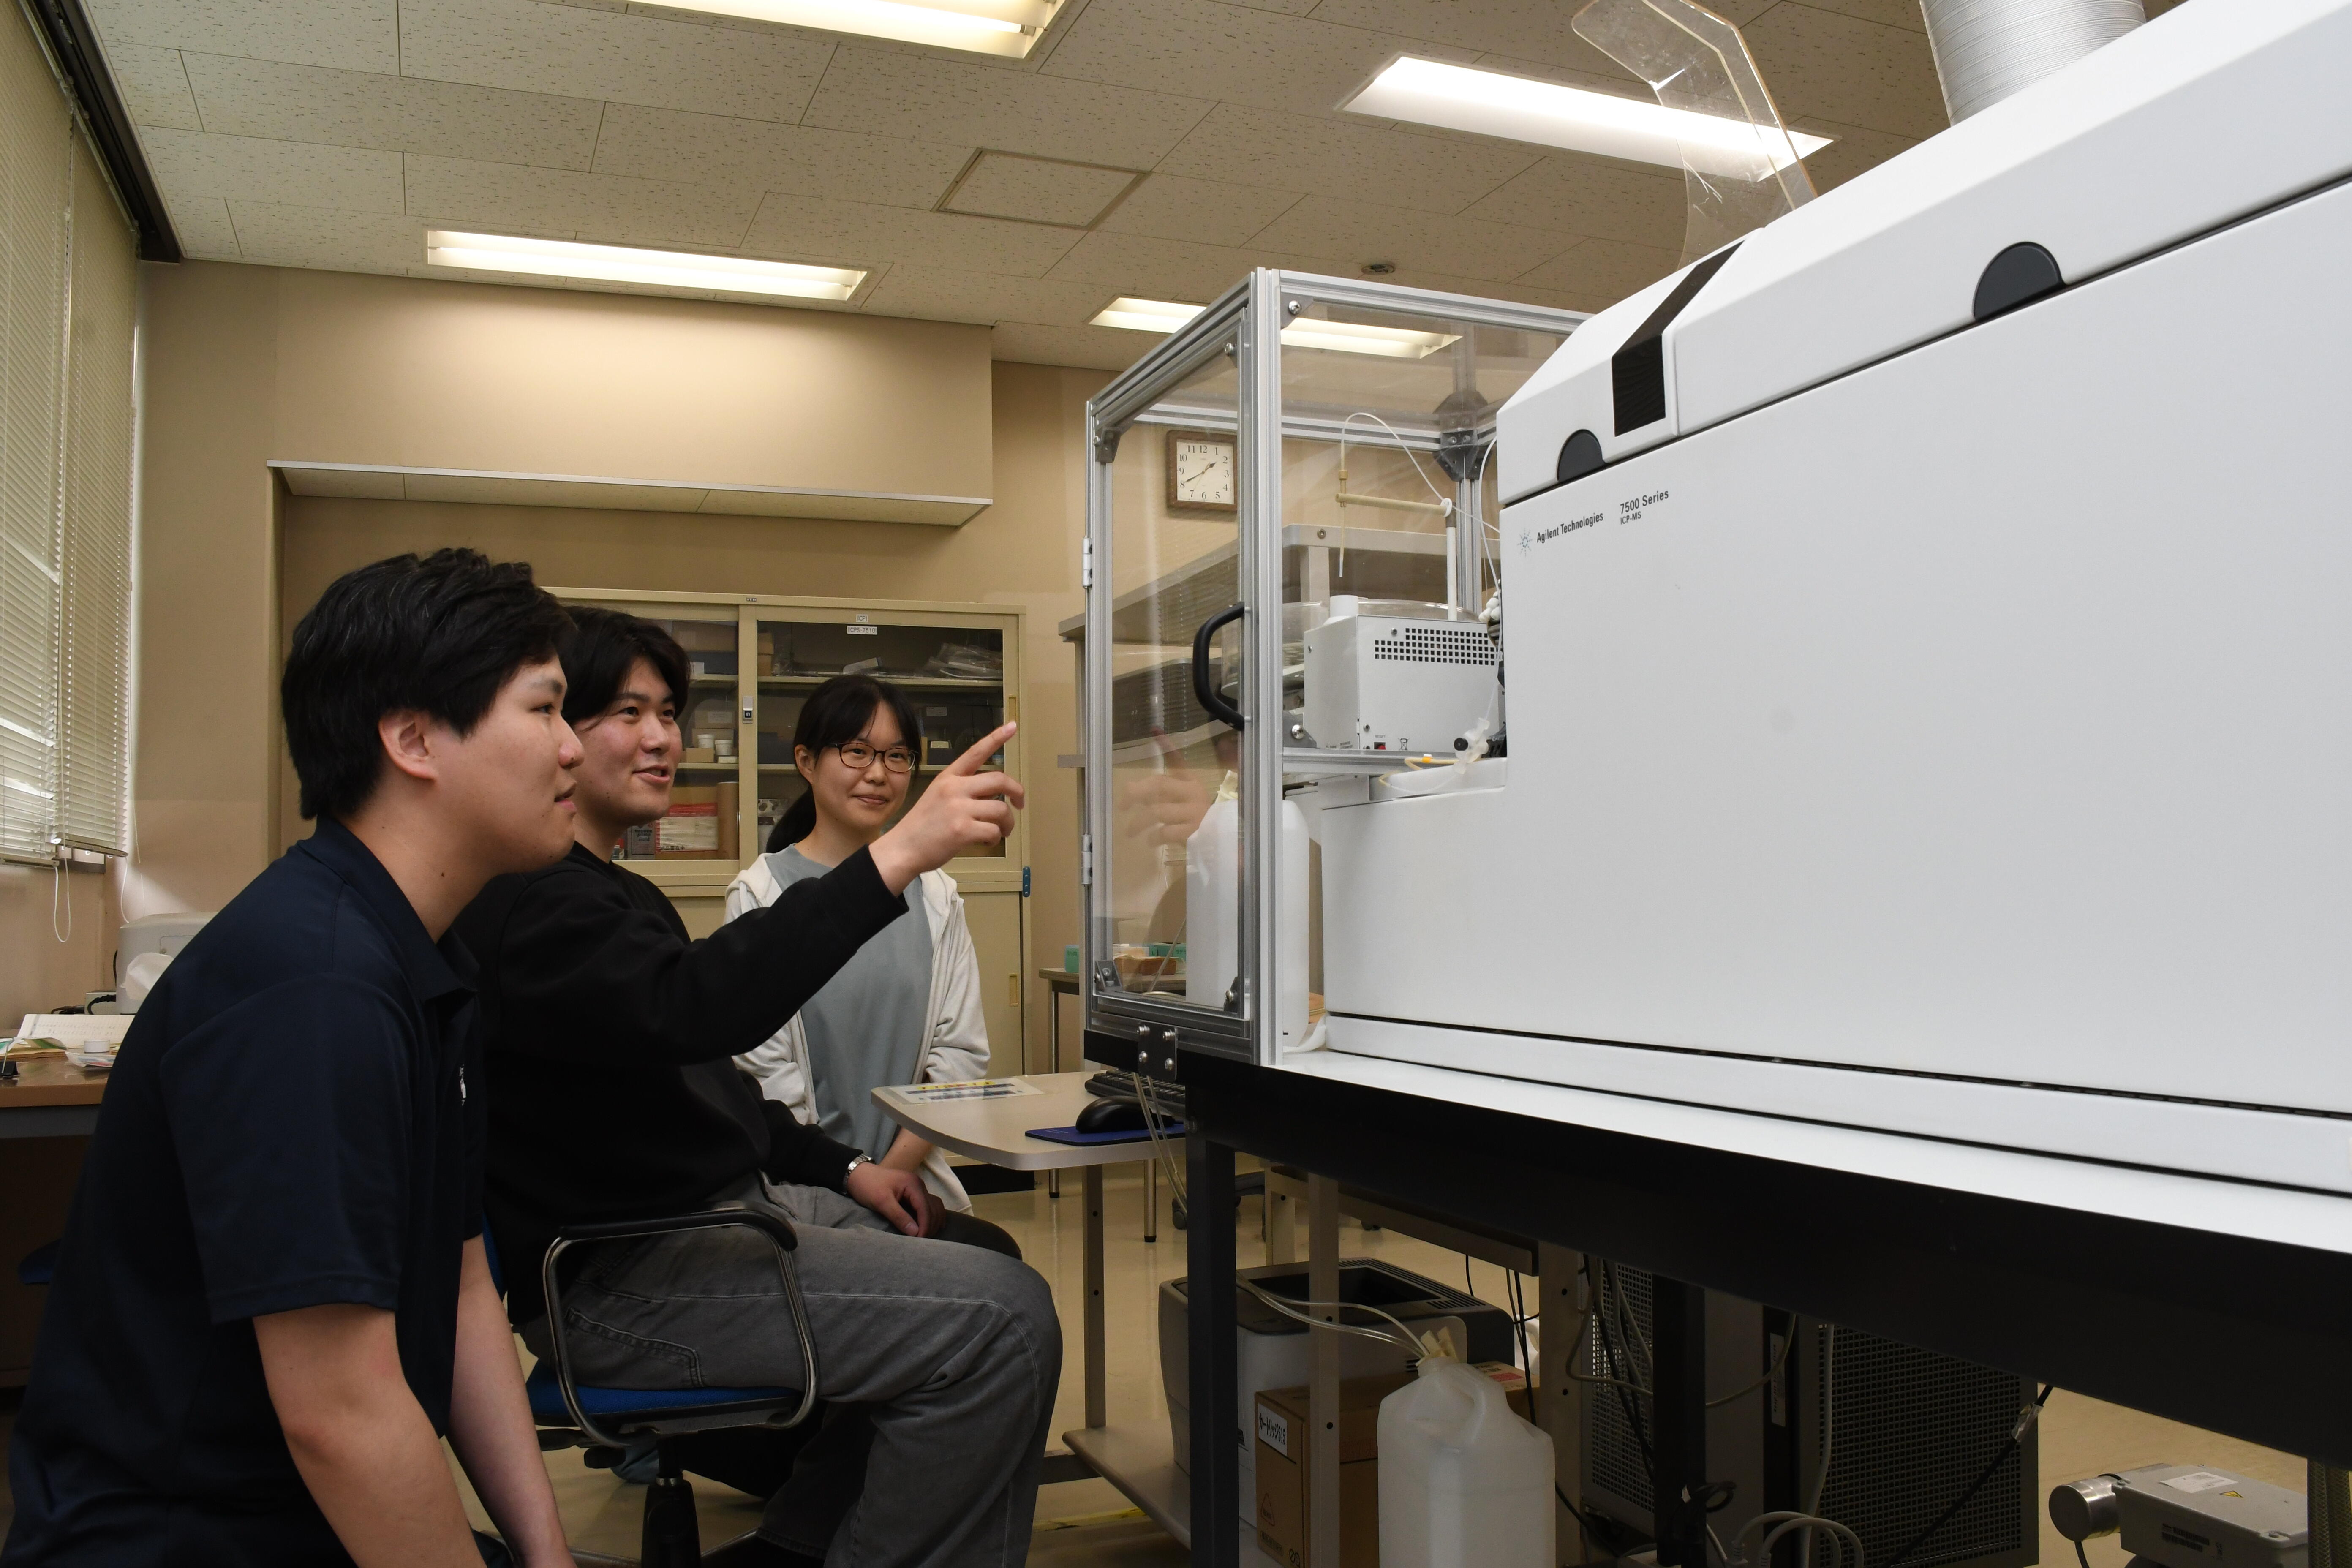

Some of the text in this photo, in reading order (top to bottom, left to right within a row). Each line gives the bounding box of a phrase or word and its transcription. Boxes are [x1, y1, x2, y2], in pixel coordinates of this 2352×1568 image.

[1620, 490, 1669, 514] 7500 Series
[1537, 512, 1603, 543] Agilent Technologies
[1620, 511, 1642, 525] ICP-MS
[1259, 1412, 1285, 1445] カートリッジ515
